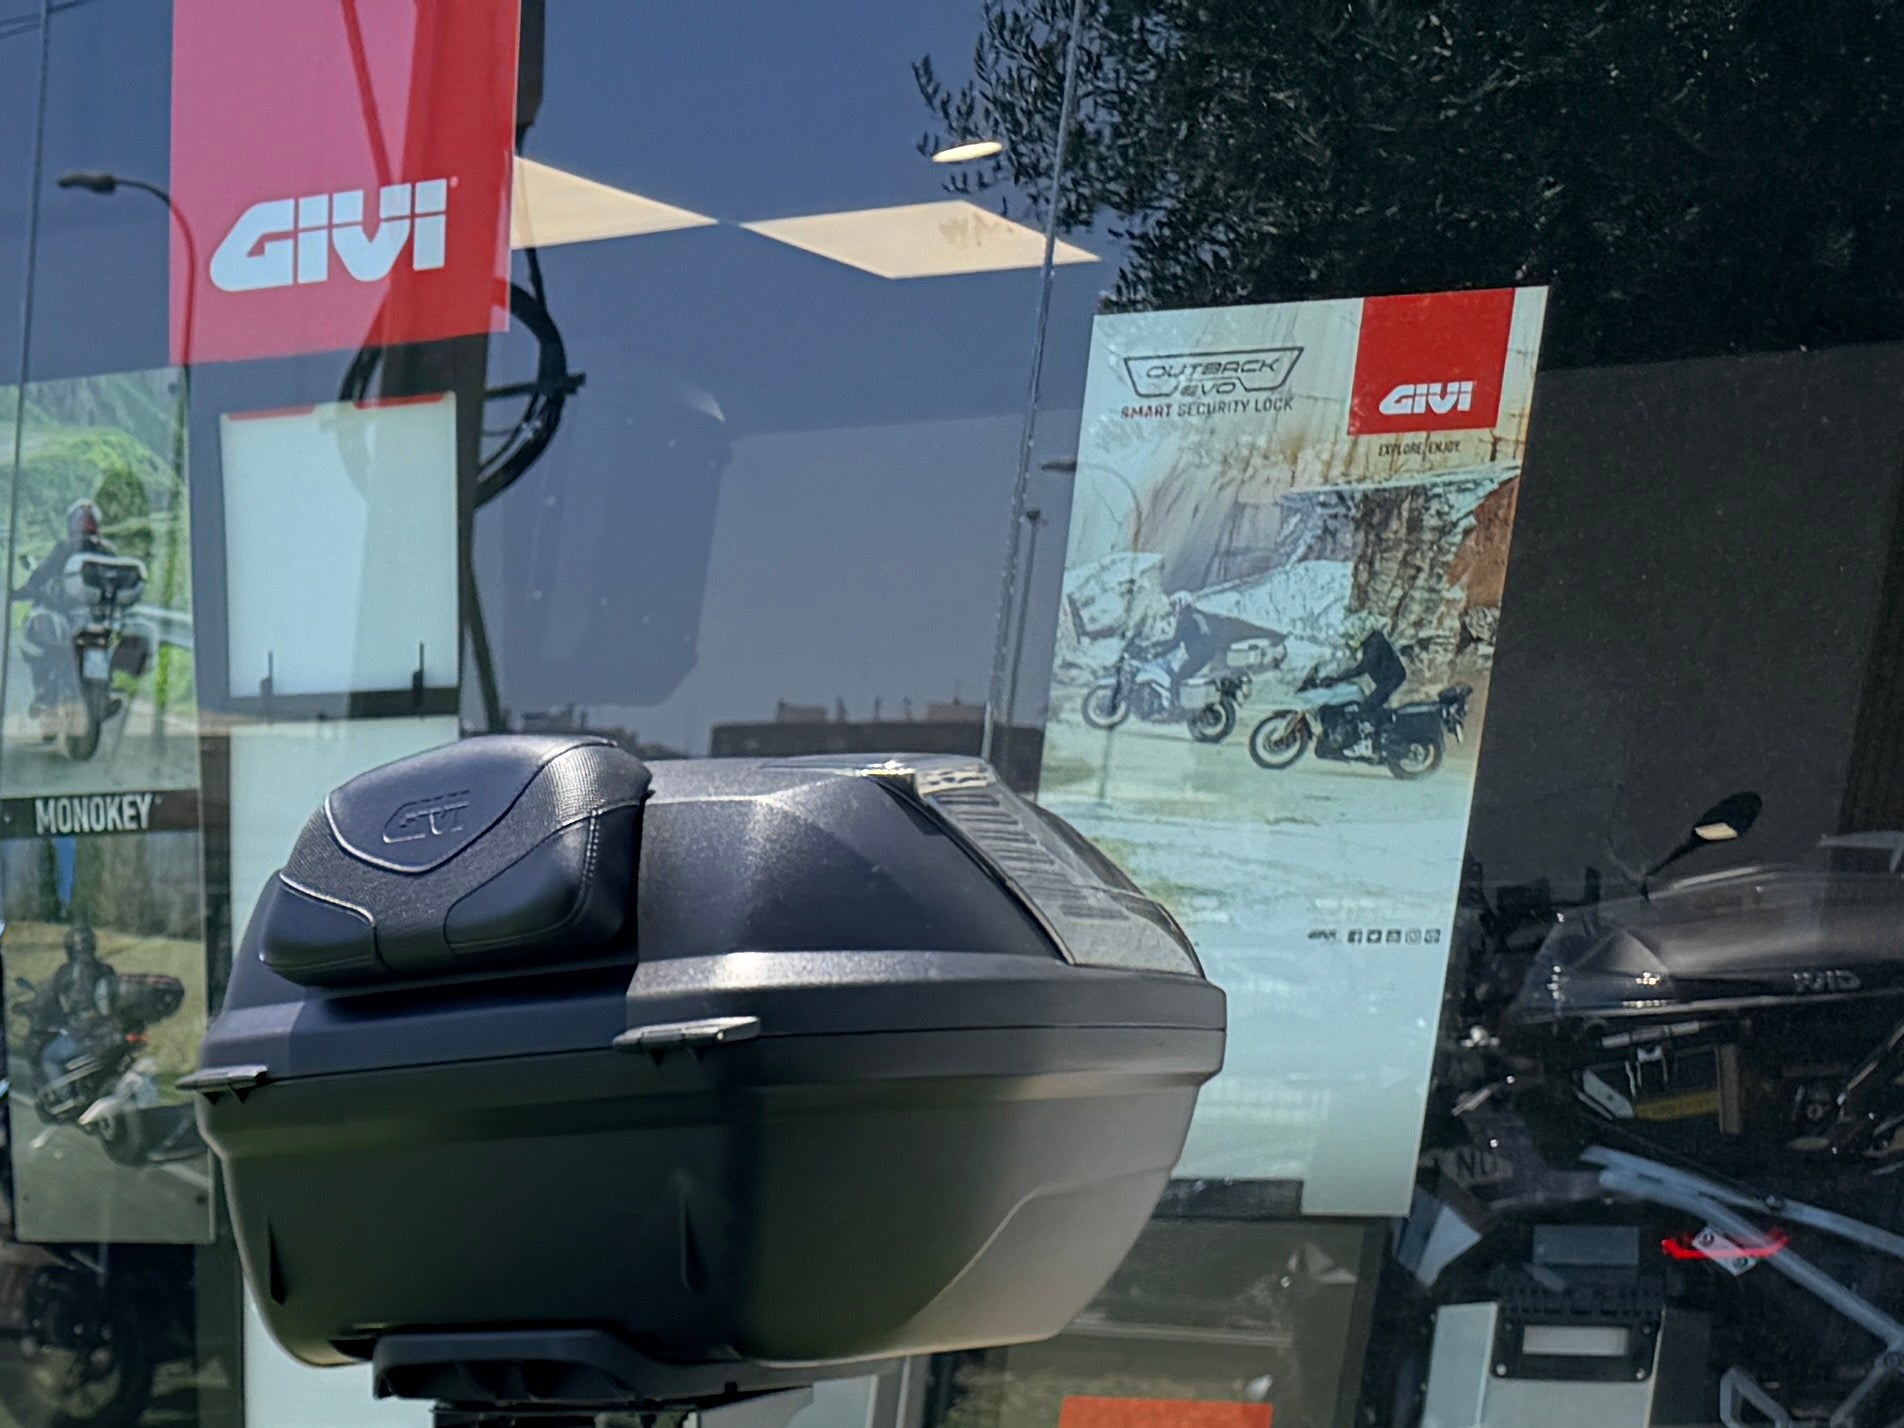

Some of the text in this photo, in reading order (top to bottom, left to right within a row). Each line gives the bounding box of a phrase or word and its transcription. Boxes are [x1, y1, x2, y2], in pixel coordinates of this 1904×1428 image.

[210, 178, 448, 292] GIVI
[1145, 359, 1281, 379] OUTBACK
[1121, 397, 1293, 419] SMART SECURITY LOCK
[1378, 381, 1474, 416] GIVI
[34, 792, 153, 836] MONOKEY
